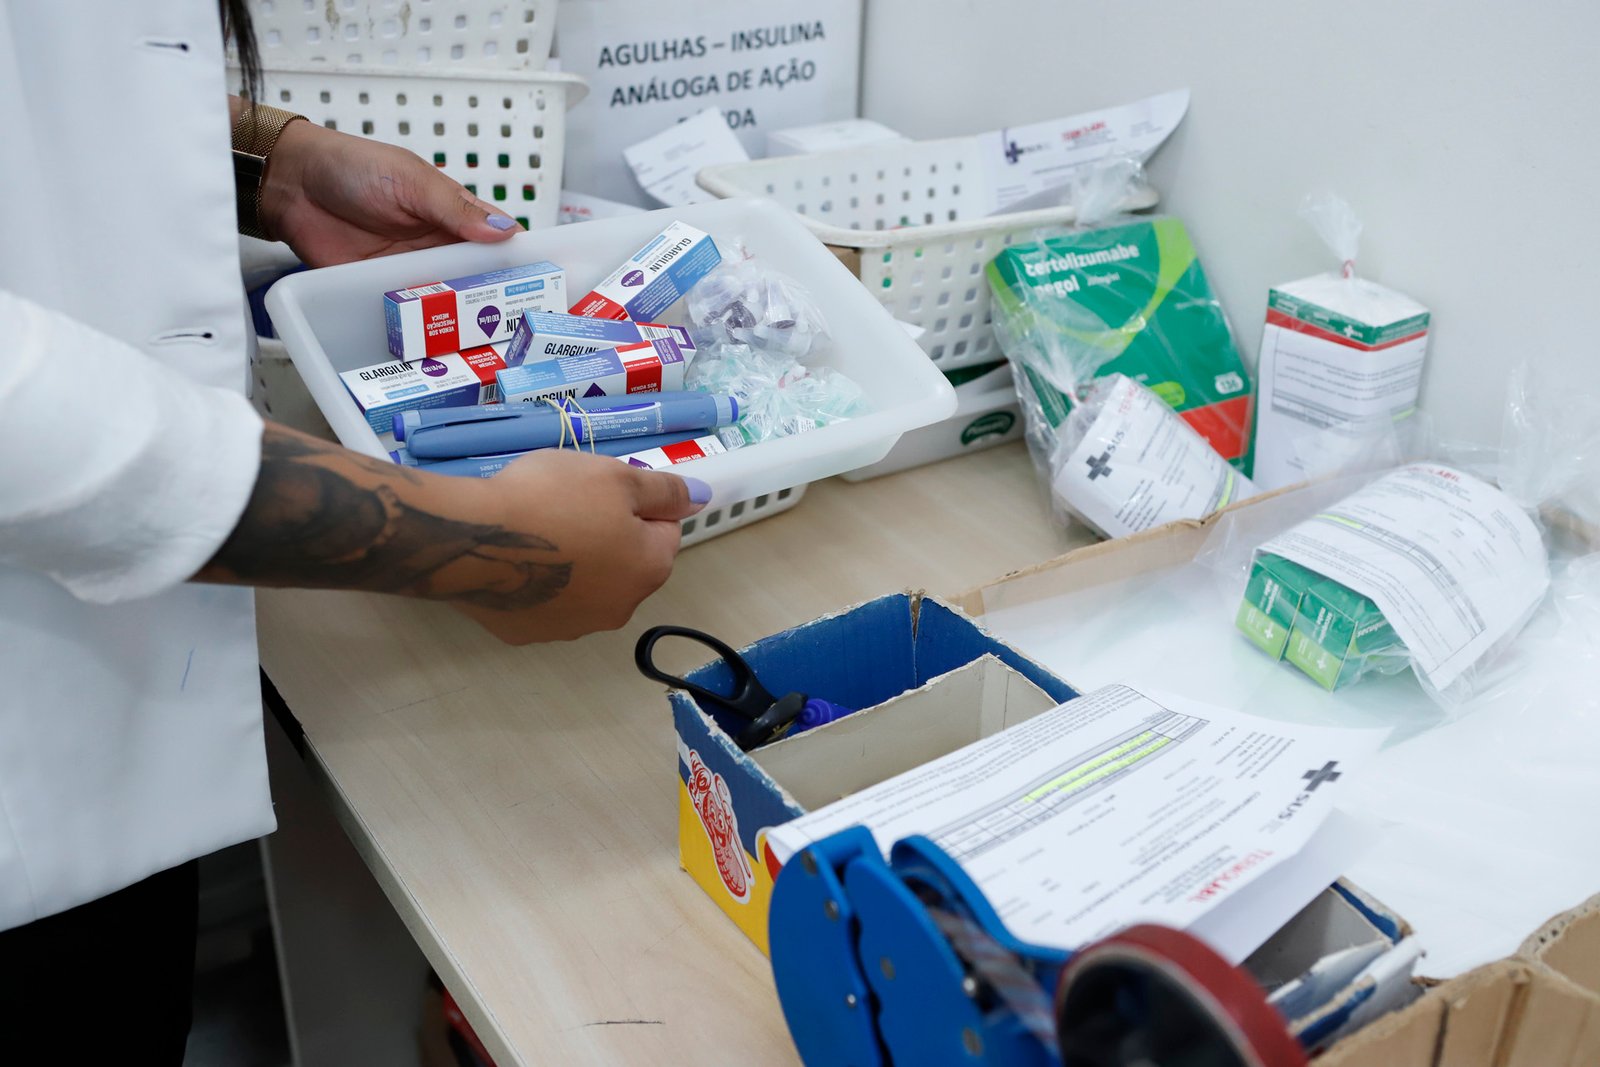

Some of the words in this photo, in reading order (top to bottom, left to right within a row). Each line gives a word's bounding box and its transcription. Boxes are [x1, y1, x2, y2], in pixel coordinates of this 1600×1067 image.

[599, 36, 706, 68] AGULHAS
[731, 20, 825, 51] INSULINA
[610, 74, 720, 107] ANÁLOGA
[727, 70, 753, 92] DE
[758, 57, 816, 90] AÇÃO
[649, 237, 692, 272] GLARGILIN
[1025, 243, 1140, 277] certolizumabe
[1033, 275, 1080, 299] pegol
[427, 319, 456, 330] PRESCRIÇÃO
[431, 312, 450, 321] MÉDICA
[428, 328, 439, 337] SOB
[439, 326, 455, 335] VENDA
[359, 361, 414, 381] GLARGILIN
[1107, 431, 1125, 454] SUS
[1277, 792, 1311, 820] SUS
